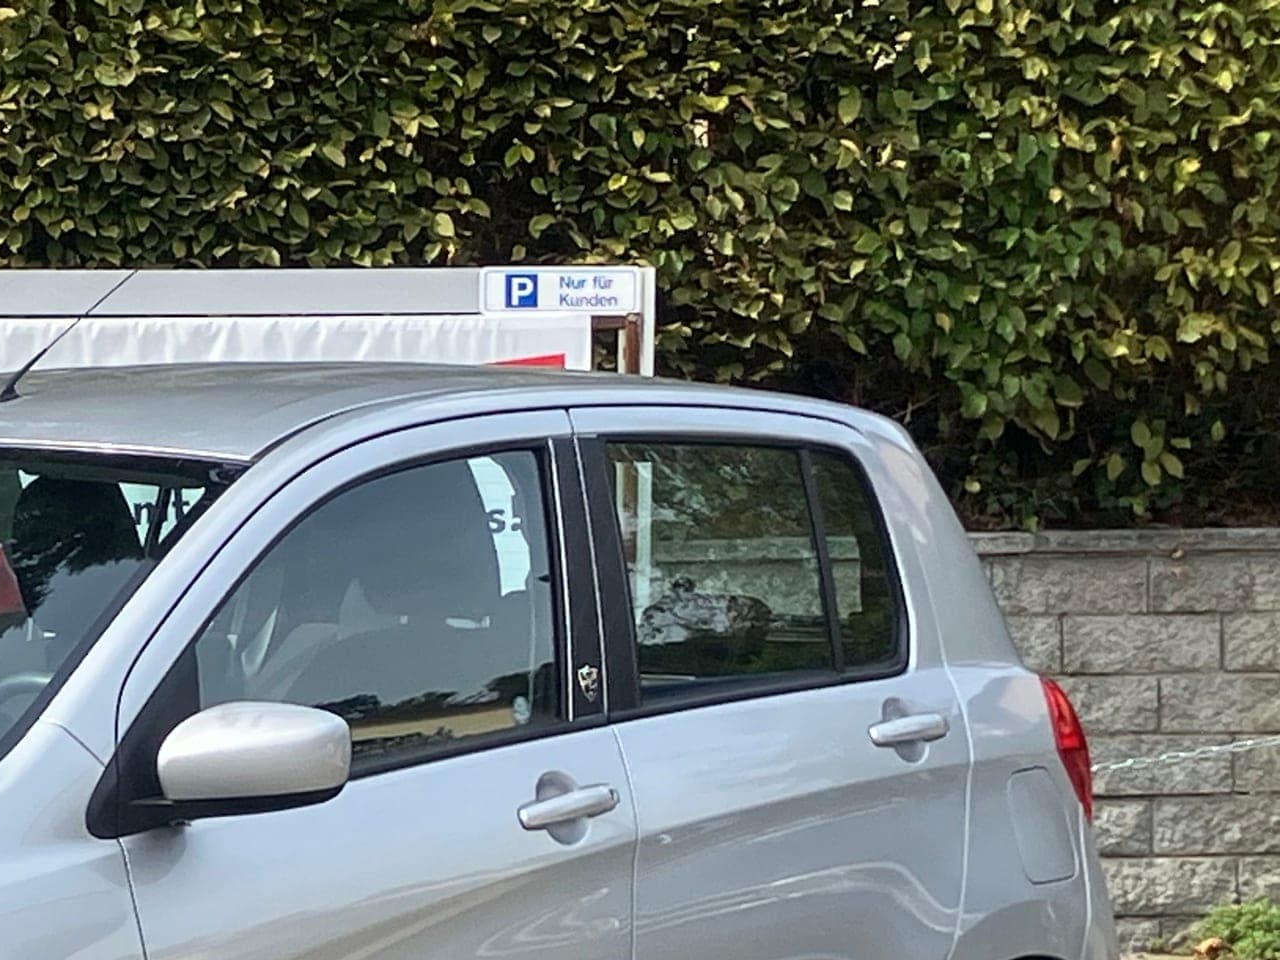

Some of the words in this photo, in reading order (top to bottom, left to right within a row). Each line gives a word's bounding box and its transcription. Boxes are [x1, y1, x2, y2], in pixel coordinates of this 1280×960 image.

[559, 275, 586, 290] Nur
[592, 275, 614, 290] für
[511, 276, 534, 307] P
[559, 293, 618, 308] Kunden
